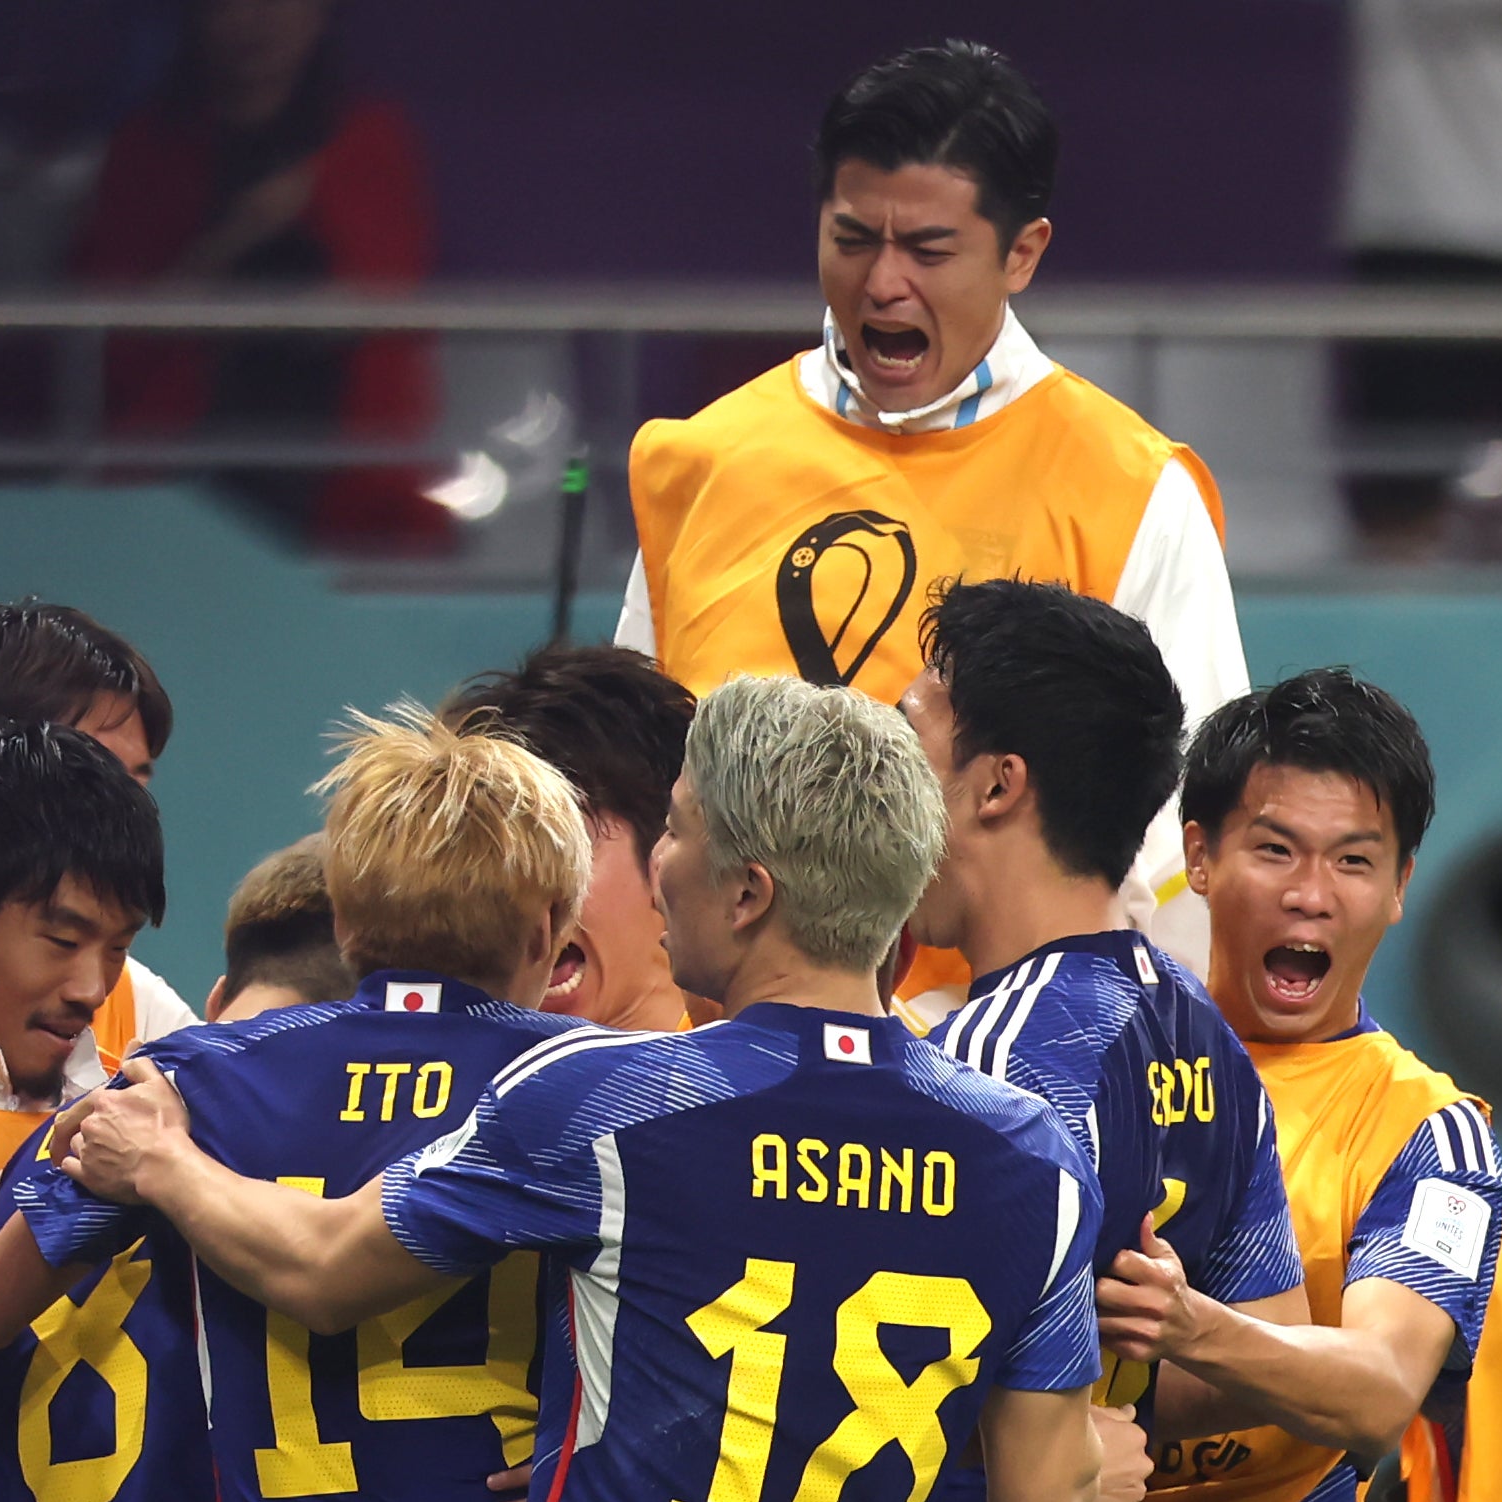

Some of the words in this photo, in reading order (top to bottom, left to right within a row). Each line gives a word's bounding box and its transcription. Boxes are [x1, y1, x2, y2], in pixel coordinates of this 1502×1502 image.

[339, 1061, 454, 1122] ITO
[751, 1133, 956, 1217] ASANO
[254, 1176, 539, 1499] 14
